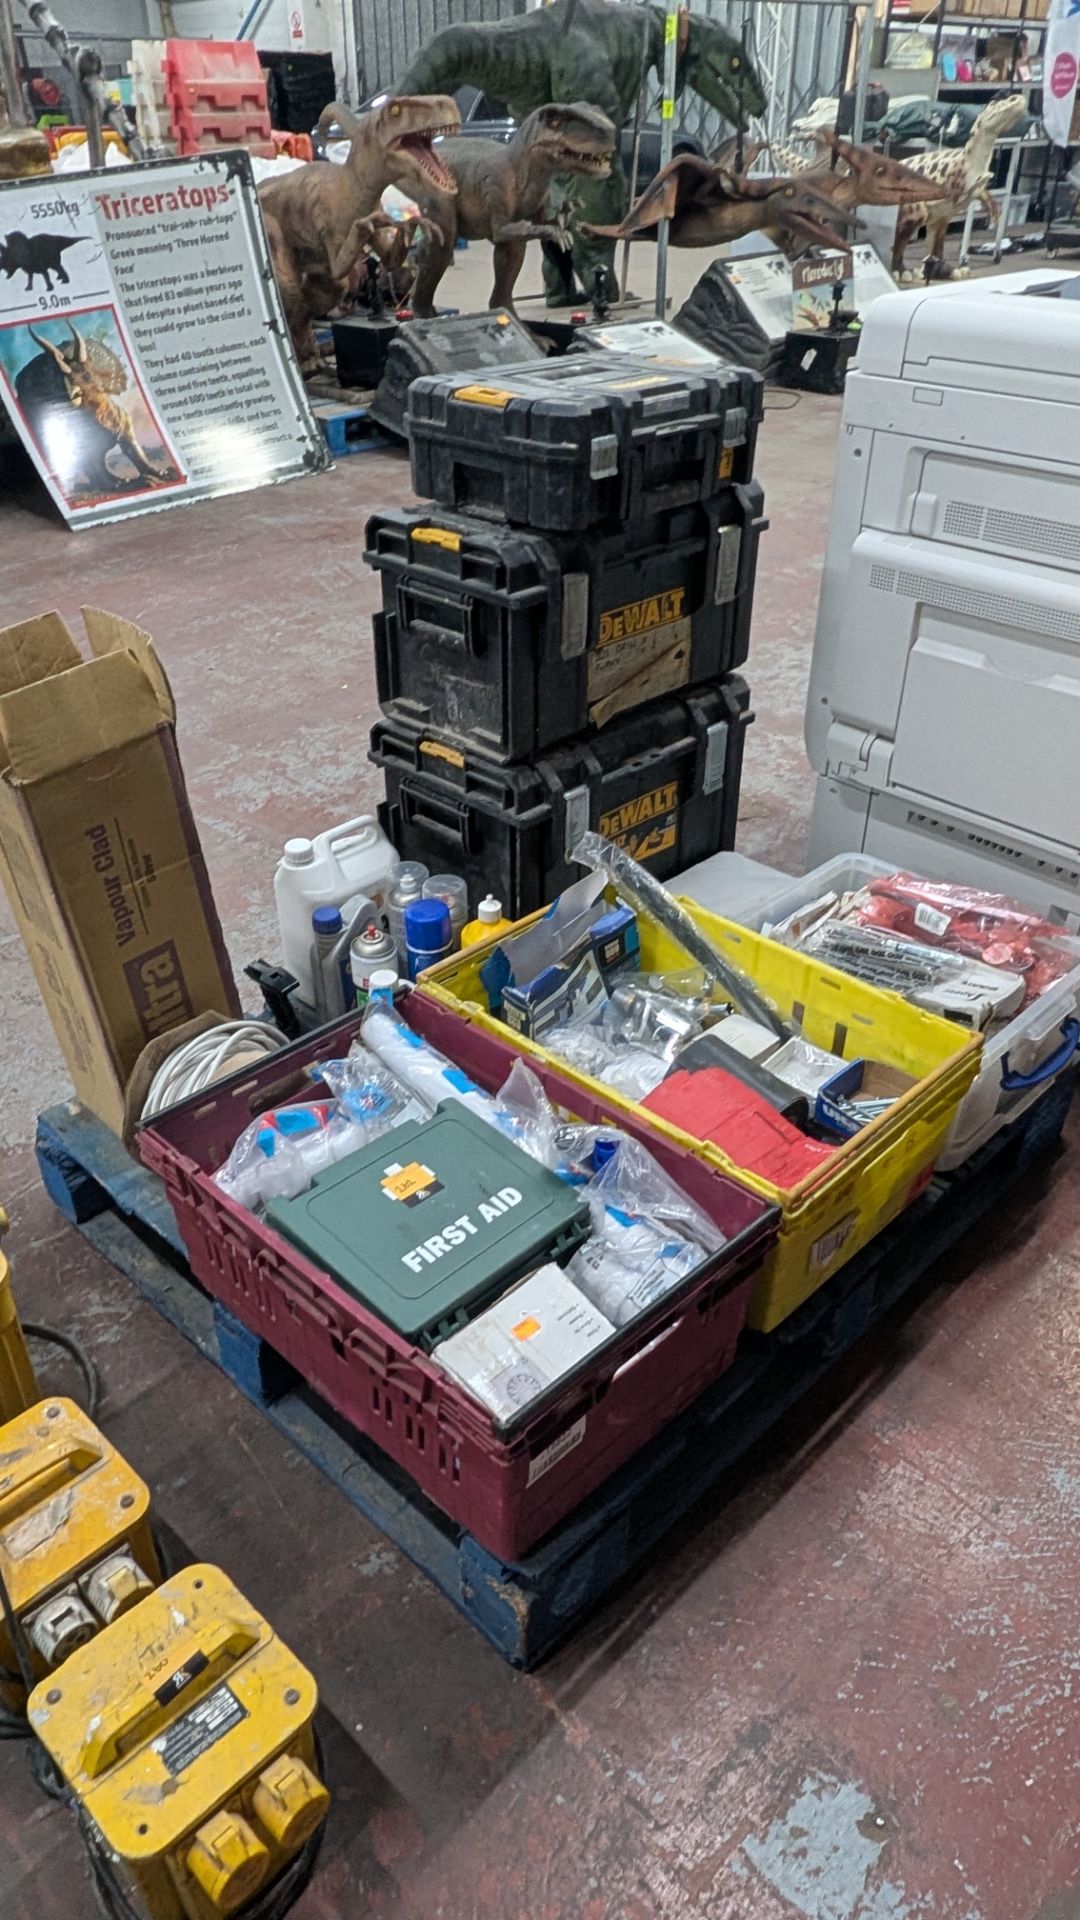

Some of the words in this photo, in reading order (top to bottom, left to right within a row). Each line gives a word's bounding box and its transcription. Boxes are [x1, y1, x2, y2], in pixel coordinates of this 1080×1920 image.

[30, 200, 80, 219] 5550kg
[95, 184, 230, 220] Triceratops
[105, 225, 156, 242] Pronounced
[111, 249, 136, 260] Greek
[137, 242, 173, 256] meaning
[200, 231, 230, 244] Horned
[120, 283, 135, 293] The
[136, 275, 182, 290] triceratops
[183, 271, 199, 280] was
[206, 264, 243, 278] herbivore
[38, 295, 71, 310] 9.0m
[124, 297, 143, 308] that
[144, 293, 164, 304] lived
[176, 286, 204, 298] million
[205, 282, 227, 295] years
[228, 280, 243, 291] ago
[129, 312, 144, 323] and
[146, 306, 176, 320] despite
[183, 302, 204, 315] plant
[204, 297, 228, 308] based
[228, 294, 245, 304] diet
[133, 327, 152, 338] they
[153, 323, 175, 334] could
[175, 320, 196, 332] grow
[196, 317, 206, 326] to
[206, 314, 220, 323] the
[220, 310, 236, 321] size
[237, 307, 246, 317] of
[144, 359, 164, 369] They
[164, 354, 180, 365] had
[192, 348, 215, 359] tooth
[249, 336, 267, 347] each
[150, 371, 178, 383] column
[179, 362, 220, 376] containing
[220, 355, 252, 367] between
[155, 386, 176, 397] three
[177, 382, 192, 392] and
[192, 379, 208, 388] five
[161, 398, 189, 411] around
[206, 389, 226, 400] teeth
[227, 388, 234, 396] in
[234, 382, 254, 394] total
[254, 379, 271, 390] with
[166, 415, 182, 423] new
[182, 409, 204, 420] teeth
[204, 400, 244, 415] constantly
[247, 411, 260, 421] and
[260, 408, 282, 418] horns
[598, 590, 685, 642] DEWALT
[600, 785, 677, 838] DEWALT
[85, 823, 116, 874] Clad
[104, 875, 137, 948] Vapour
[401, 1214, 479, 1273] FIRST
[477, 1187, 523, 1224] AID
